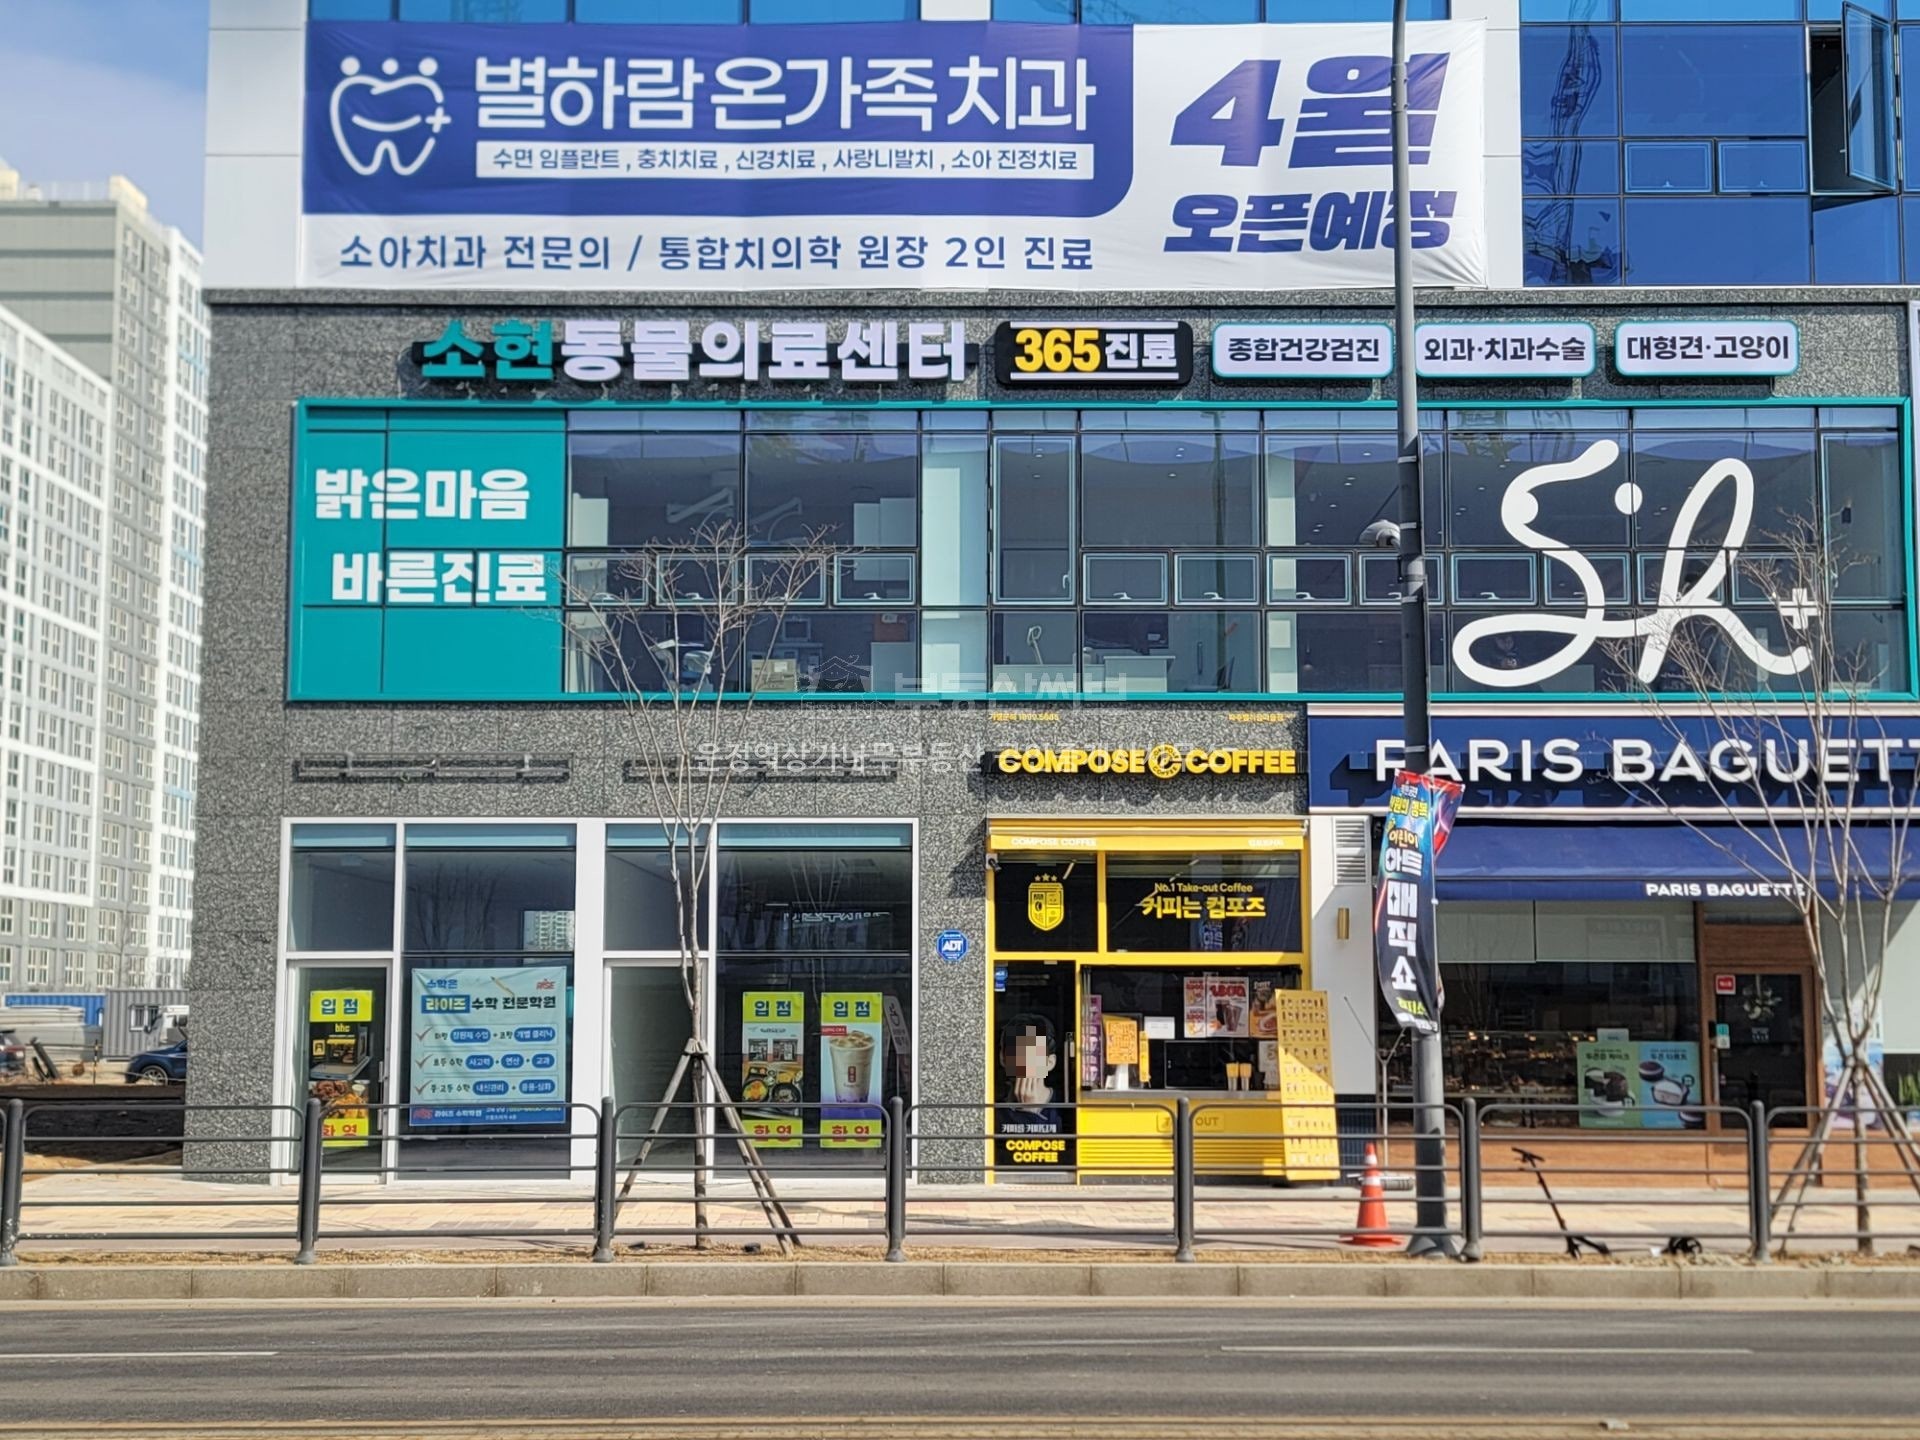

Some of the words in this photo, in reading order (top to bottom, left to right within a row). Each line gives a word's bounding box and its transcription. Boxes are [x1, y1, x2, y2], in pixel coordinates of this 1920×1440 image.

[1170, 52, 1450, 168] 4월
[494, 149, 532, 169] 수면
[951, 150, 991, 169] 소아
[997, 150, 1078, 170] 진정치료
[1164, 191, 1457, 252] 오픈예정
[340, 236, 487, 269] 소아치과
[503, 235, 609, 271] 전문의
[659, 236, 841, 270] 통합치의학
[857, 236, 928, 270] 원장
[946, 236, 1005, 270] 2인
[1024, 237, 1094, 270] 진료
[1228, 337, 1380, 362] 종합건강검진
[1424, 336, 1586, 362] 외과·치과수술
[1627, 335, 1790, 360] 대형견·고양이
[315, 467, 530, 520] 밝은마음
[332, 552, 547, 602] 바른진료
[998, 748, 1145, 774] COMPOSE
[1185, 749, 1297, 774] COFFEE
[1011, 837, 1058, 847] COMPOSE
[1061, 837, 1097, 847] COFFEE
[1178, 882, 1218, 893] Take-out
[1220, 882, 1254, 893] Coffee
[1645, 883, 1701, 896] PARIS
[1706, 883, 1805, 897] BAGUETTE
[1141, 895, 1202, 919] 커피는
[1206, 895, 1267, 919] 컴포즈
[942, 940, 963, 952] ADT
[425, 997, 467, 1011] 라이즈
[471, 996, 498, 1010] 수학
[502, 996, 557, 1010] 전문학원
[1195, 1116, 1220, 1127] OUT
[1005, 1140, 1066, 1151] COMPOSE
[1013, 1151, 1058, 1162] COFFEE
